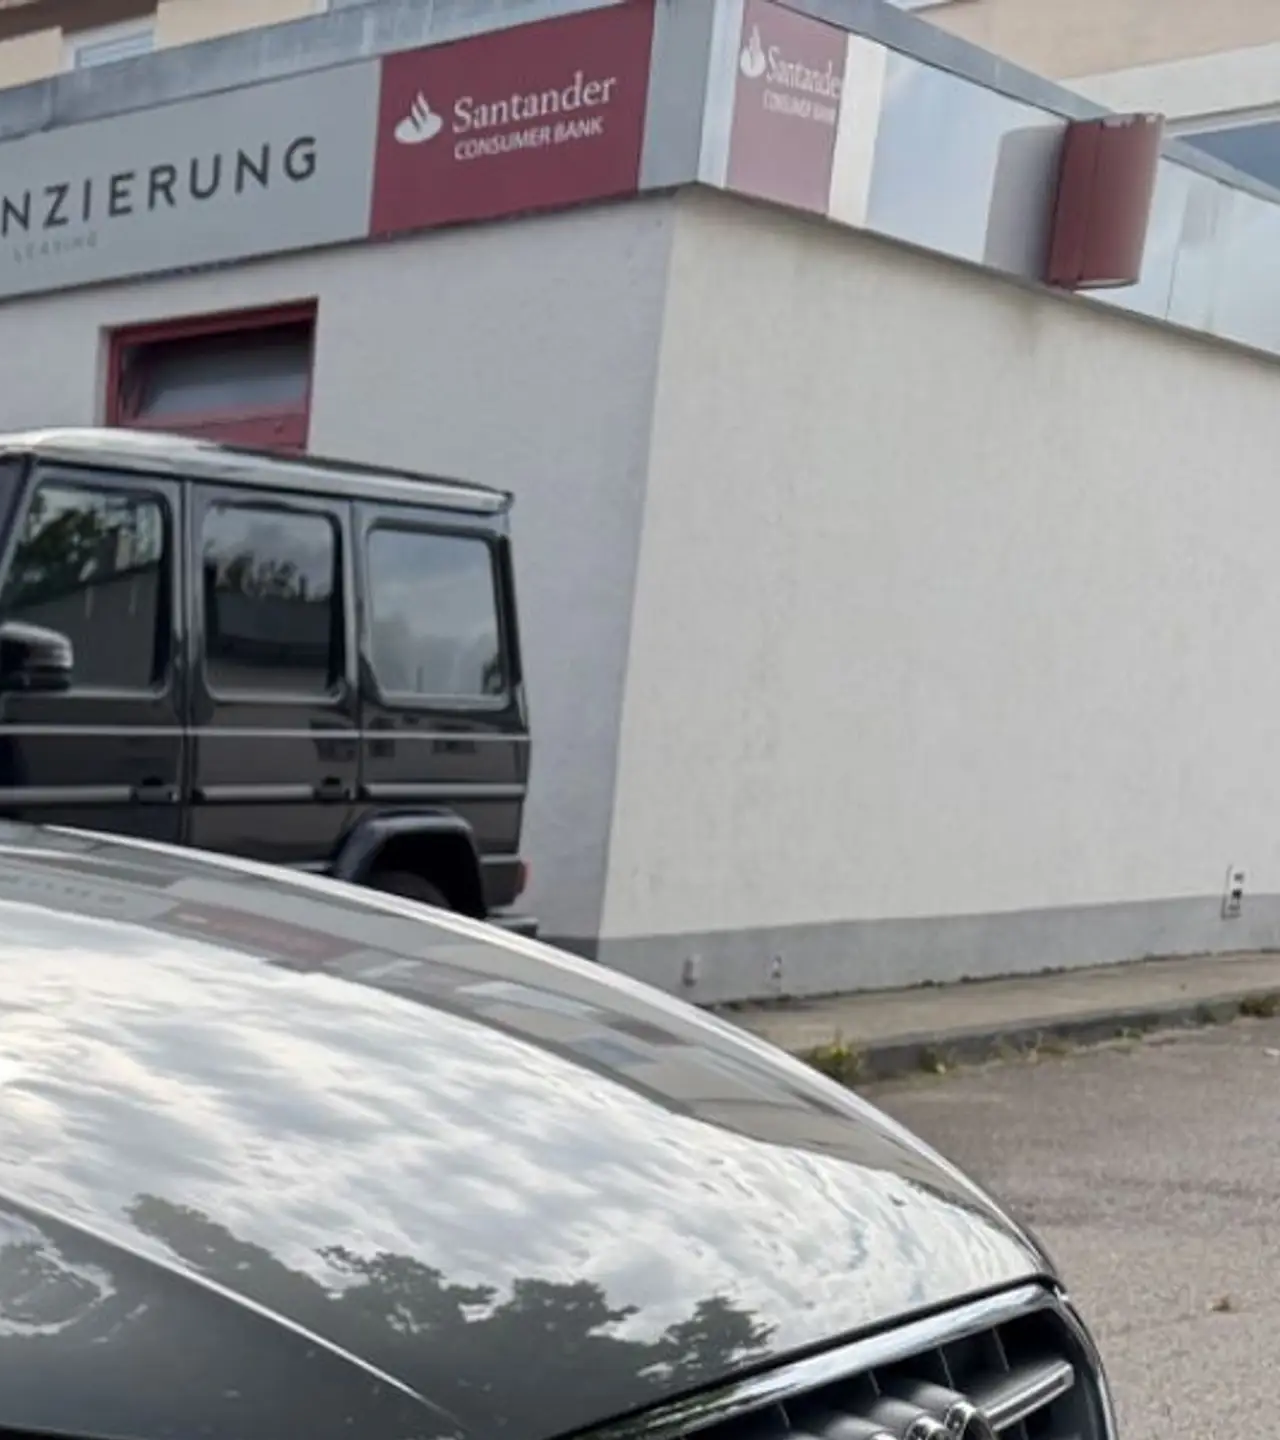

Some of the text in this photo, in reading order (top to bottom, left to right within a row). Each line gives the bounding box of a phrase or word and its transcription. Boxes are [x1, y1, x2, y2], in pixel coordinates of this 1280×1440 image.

[452, 70, 617, 134] Santander
[454, 116, 604, 161] CONSUMER BANK
